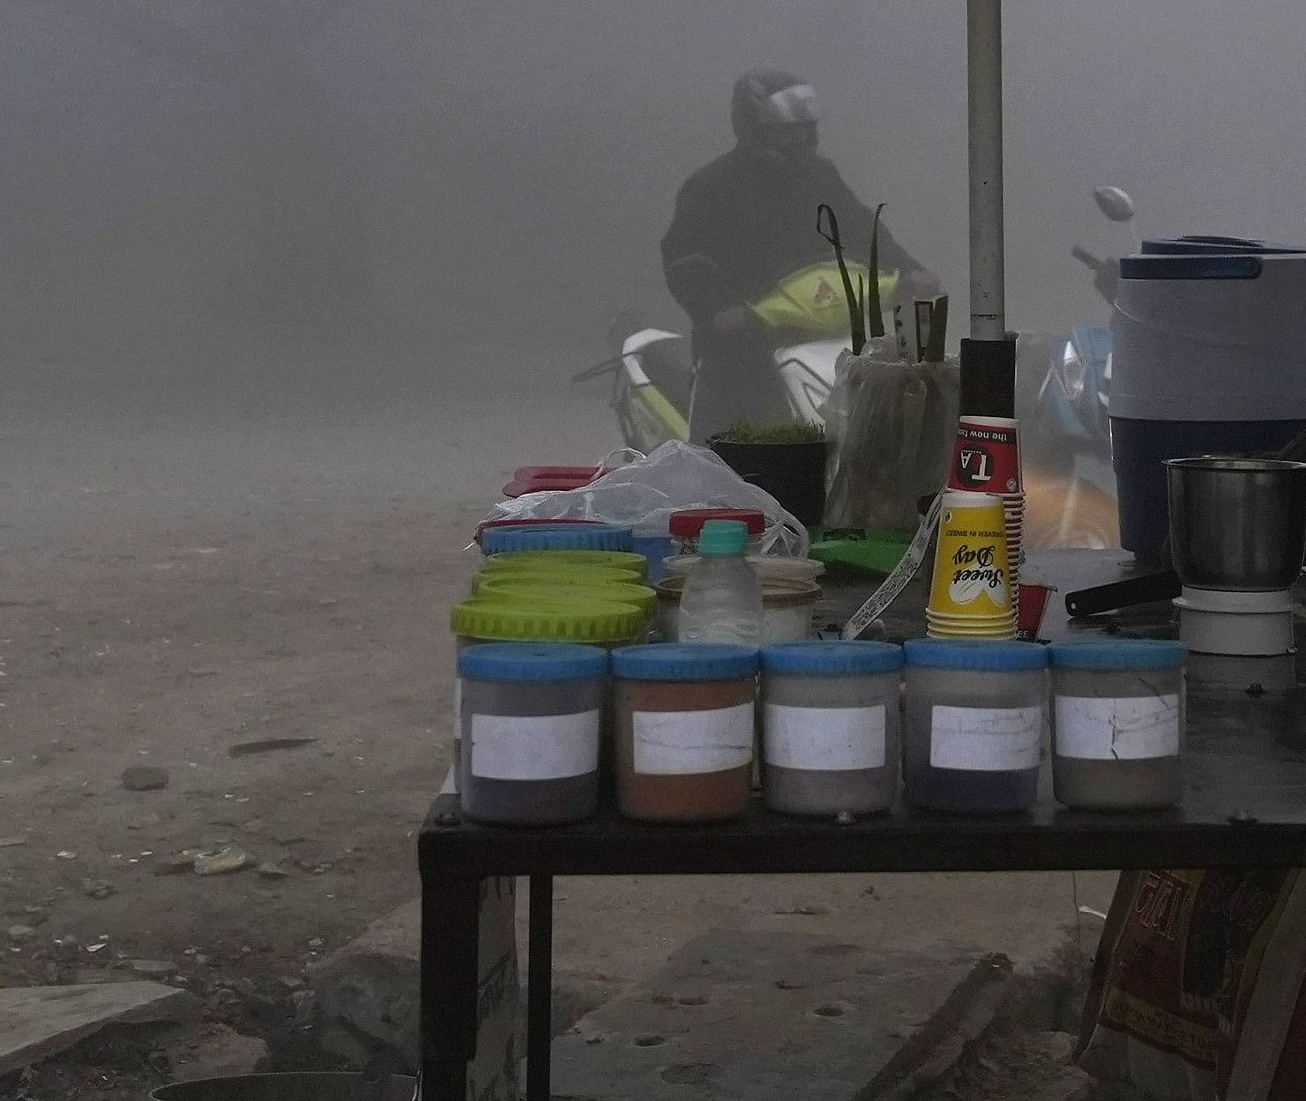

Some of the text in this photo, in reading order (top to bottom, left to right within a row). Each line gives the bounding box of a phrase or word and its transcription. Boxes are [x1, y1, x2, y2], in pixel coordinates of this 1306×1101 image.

[969, 431, 989, 439] new
[992, 432, 1007, 442] the
[953, 545, 995, 568] Day
[953, 569, 1003, 589] Sweet
